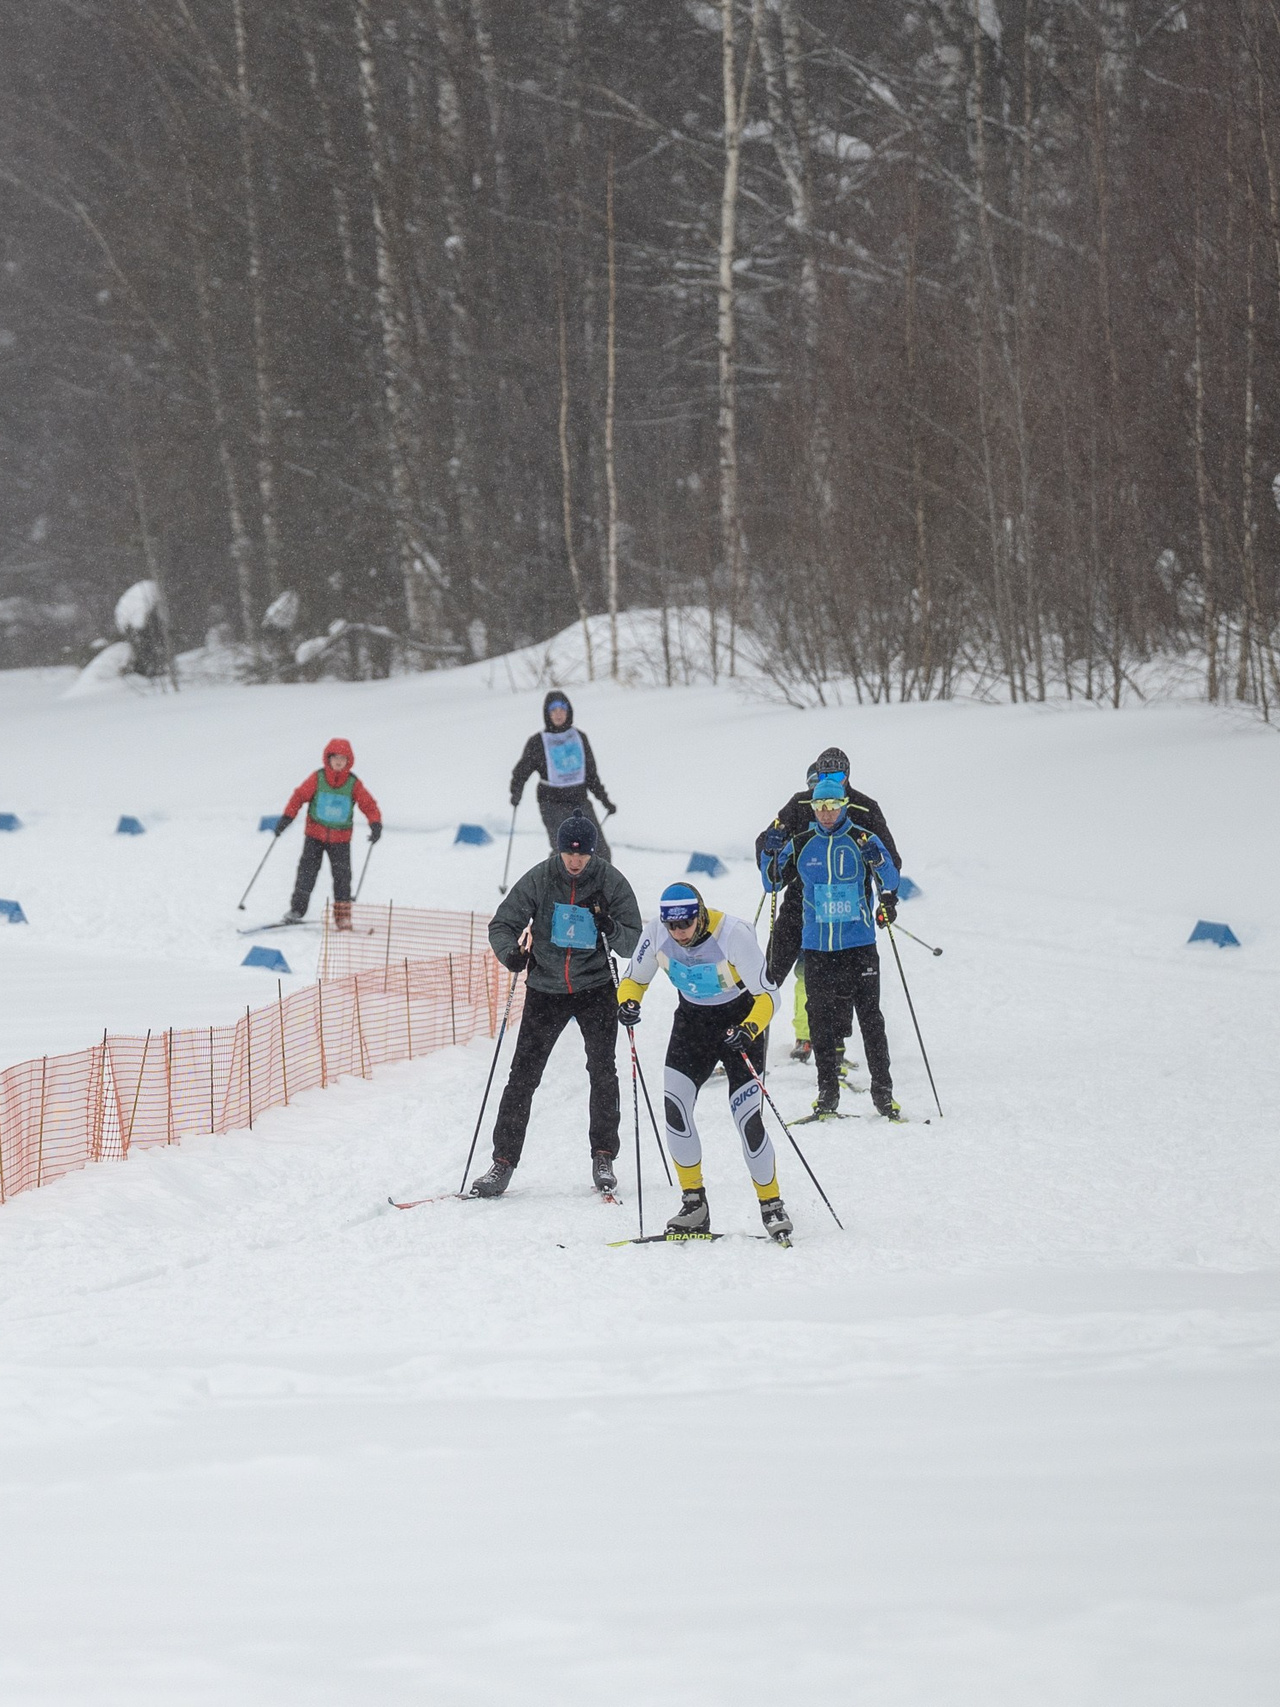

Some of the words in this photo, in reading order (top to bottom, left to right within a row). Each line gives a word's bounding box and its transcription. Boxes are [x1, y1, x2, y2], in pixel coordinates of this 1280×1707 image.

[822, 900, 852, 915] 1886
[566, 924, 576, 939] 4
[687, 982, 699, 994] 2
